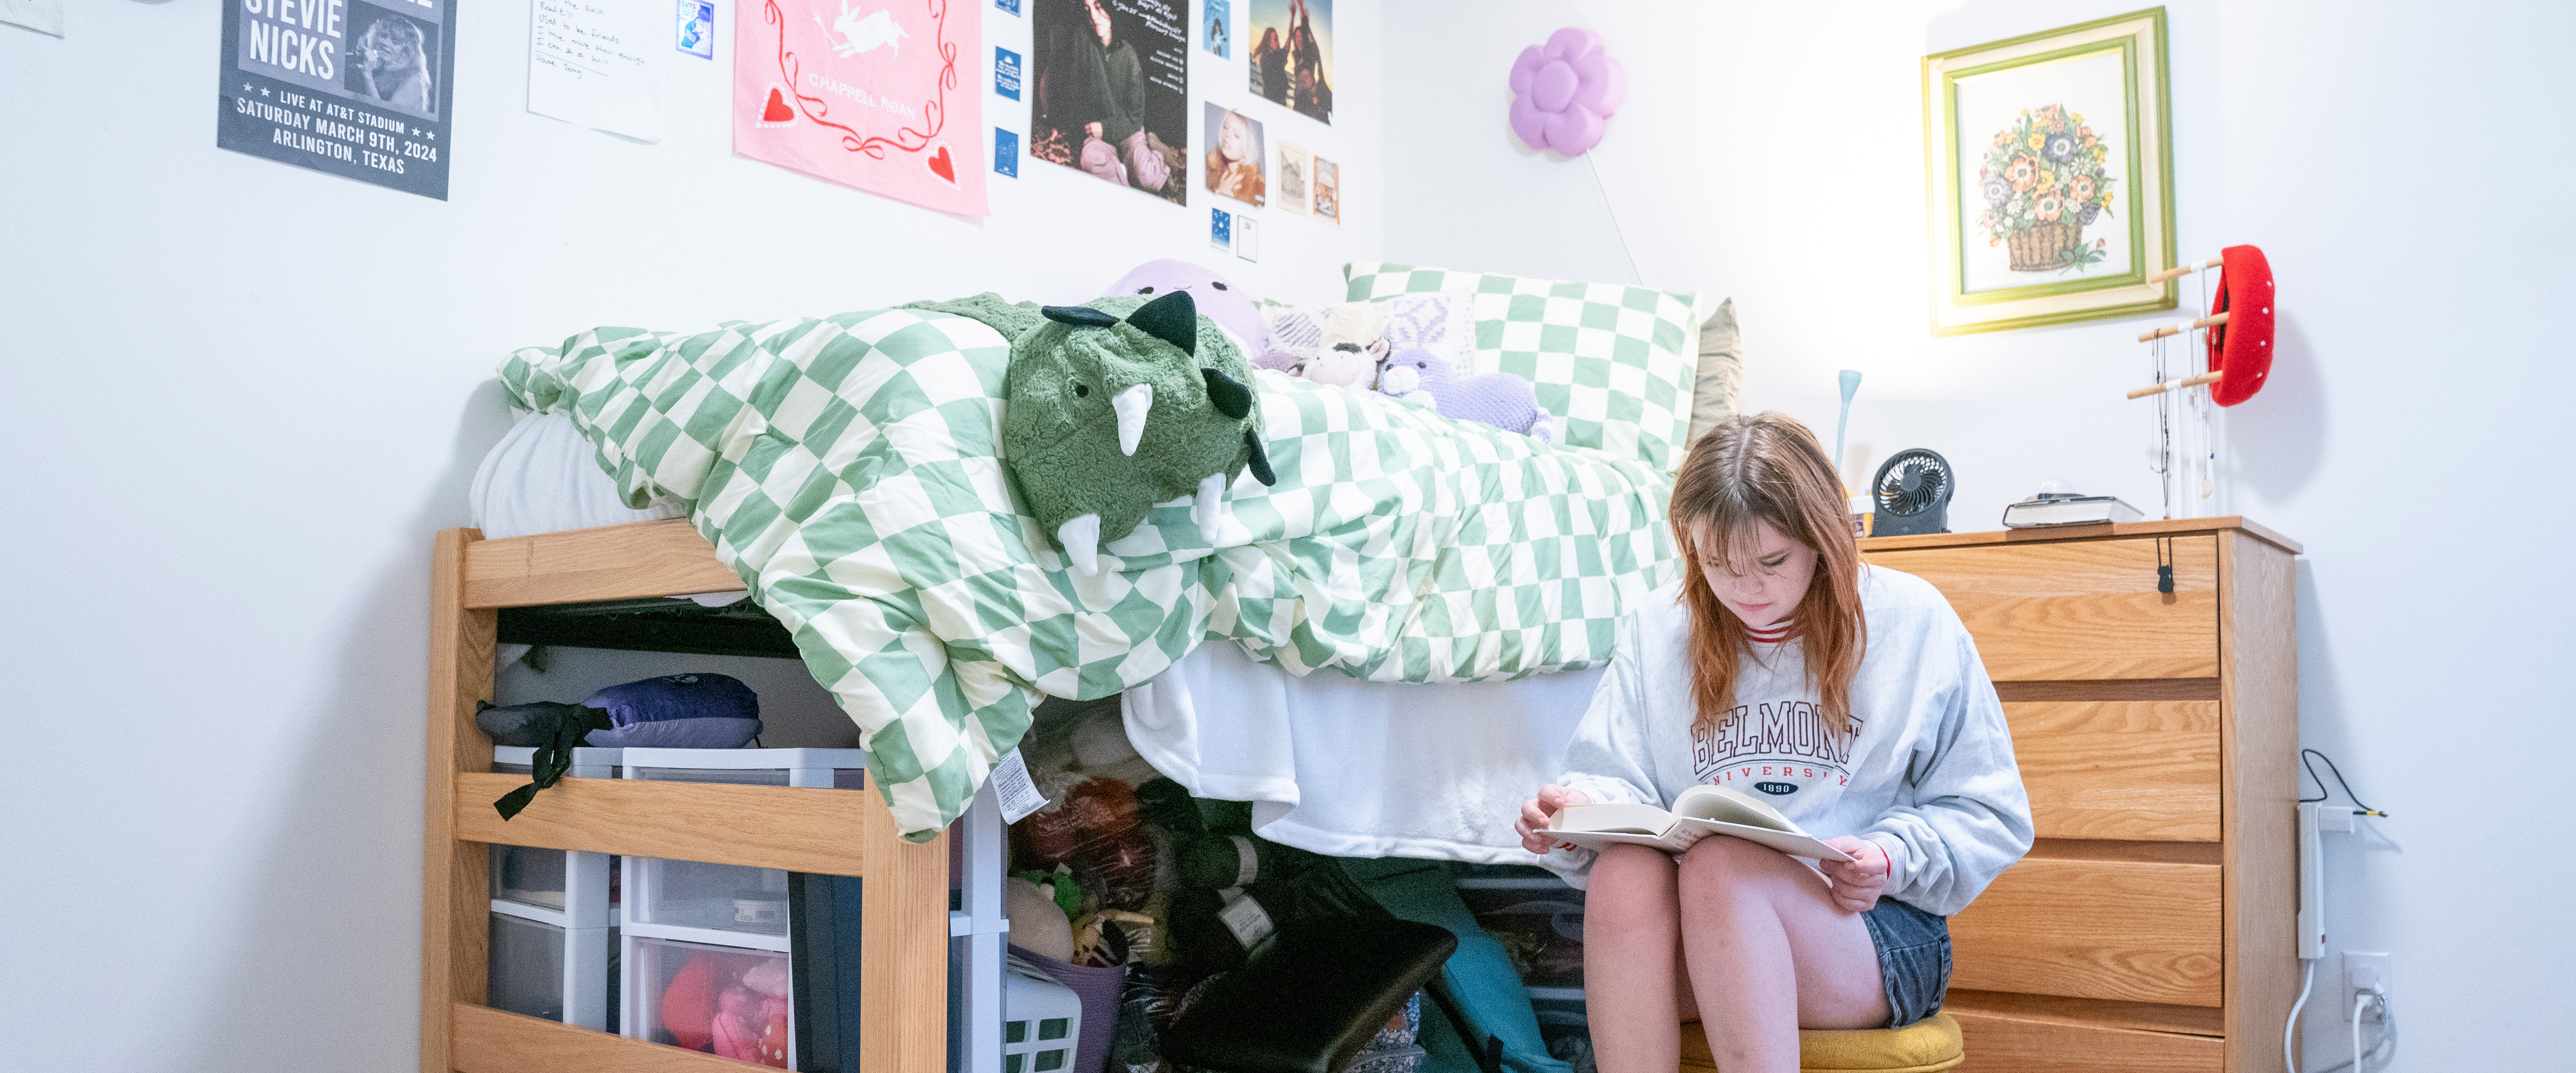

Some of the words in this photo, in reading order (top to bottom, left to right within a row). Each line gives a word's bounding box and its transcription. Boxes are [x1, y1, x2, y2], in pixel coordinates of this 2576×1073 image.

[539, 14, 556, 25] Used
[564, 21, 570, 30] to
[576, 26, 587, 35] be
[586, 5, 604, 15] Rain
[250, 19, 334, 80] NICKS
[537, 26, 544, 34] I
[548, 28, 565, 41] have
[571, 39, 590, 49] more
[595, 45, 613, 55] than
[618, 53, 645, 65] enough
[548, 43, 562, 51] can
[564, 63, 582, 79] Song
[808, 73, 877, 108] CHAPPELL
[881, 96, 915, 119] ROAN
[280, 91, 305, 108] LIVE
[309, 99, 322, 112] AT
[327, 103, 354, 121] AT&T
[358, 112, 404, 134] STADIUM
[237, 97, 310, 130] SATURDAY
[316, 118, 364, 144] MARCH
[369, 132, 399, 155] 9TH,
[404, 141, 437, 162] 2024
[273, 128, 357, 165] ARLINGTON,
[362, 150, 404, 174] TEXAS
[1690, 701, 1863, 776] BELMONT
[1009, 782, 1027, 797] INSTRUCTION
[1703, 767, 1847, 785] NIVERSIY
[1763, 783, 1789, 793] 1890
